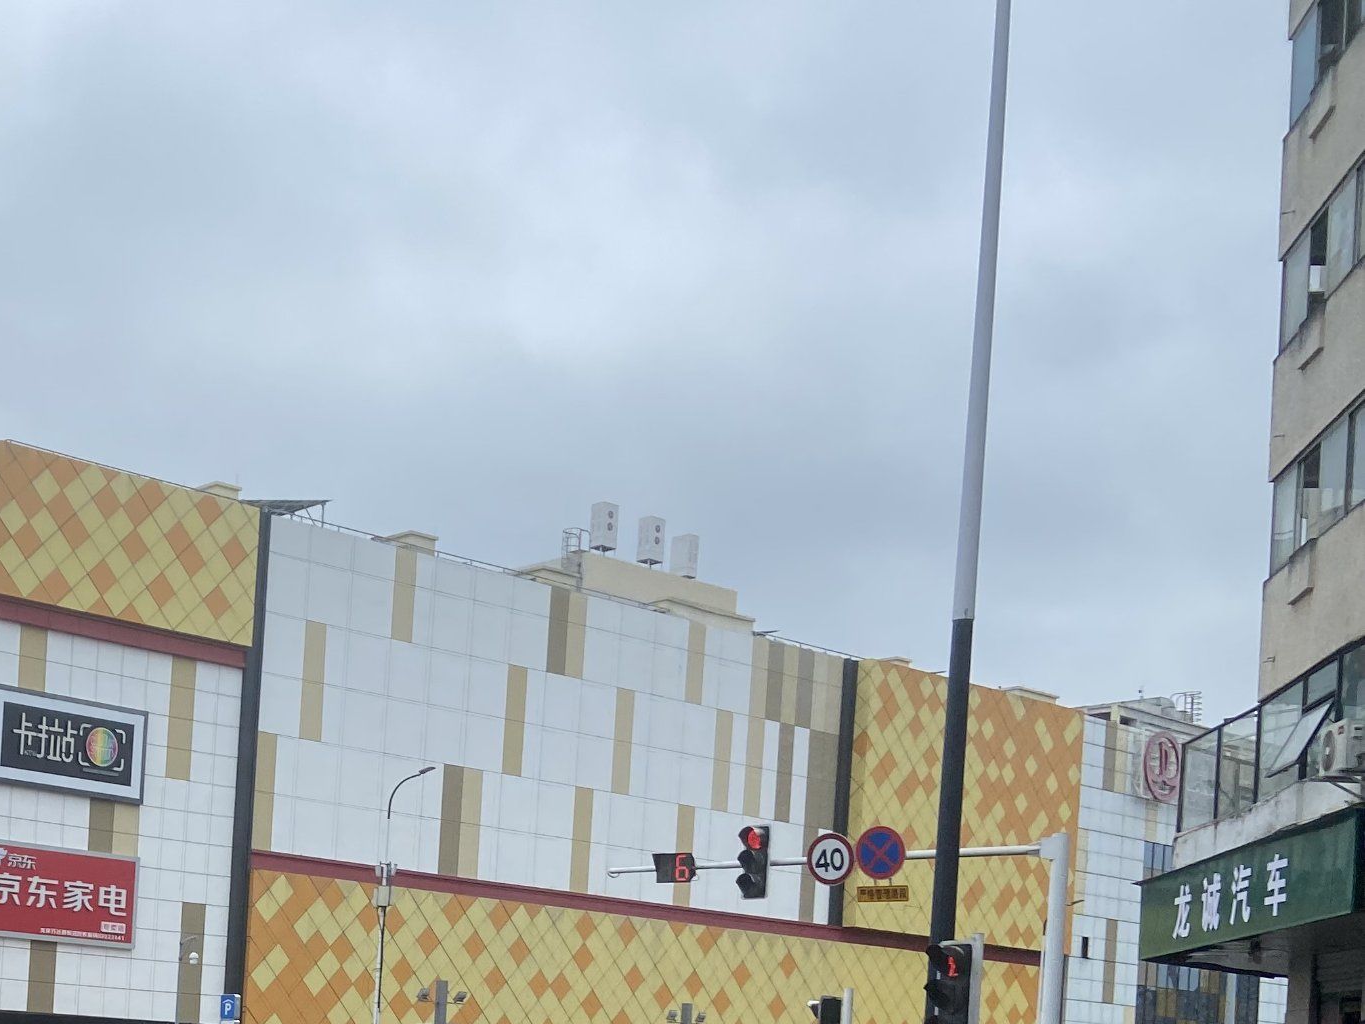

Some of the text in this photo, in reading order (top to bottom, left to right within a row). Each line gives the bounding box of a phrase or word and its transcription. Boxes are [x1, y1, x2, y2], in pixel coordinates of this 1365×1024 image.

[7, 853, 36, 870] 京东
[675, 854, 690, 881] 6
[815, 847, 844, 872] 40
[1172, 853, 1288, 940] 龙诚汽车
